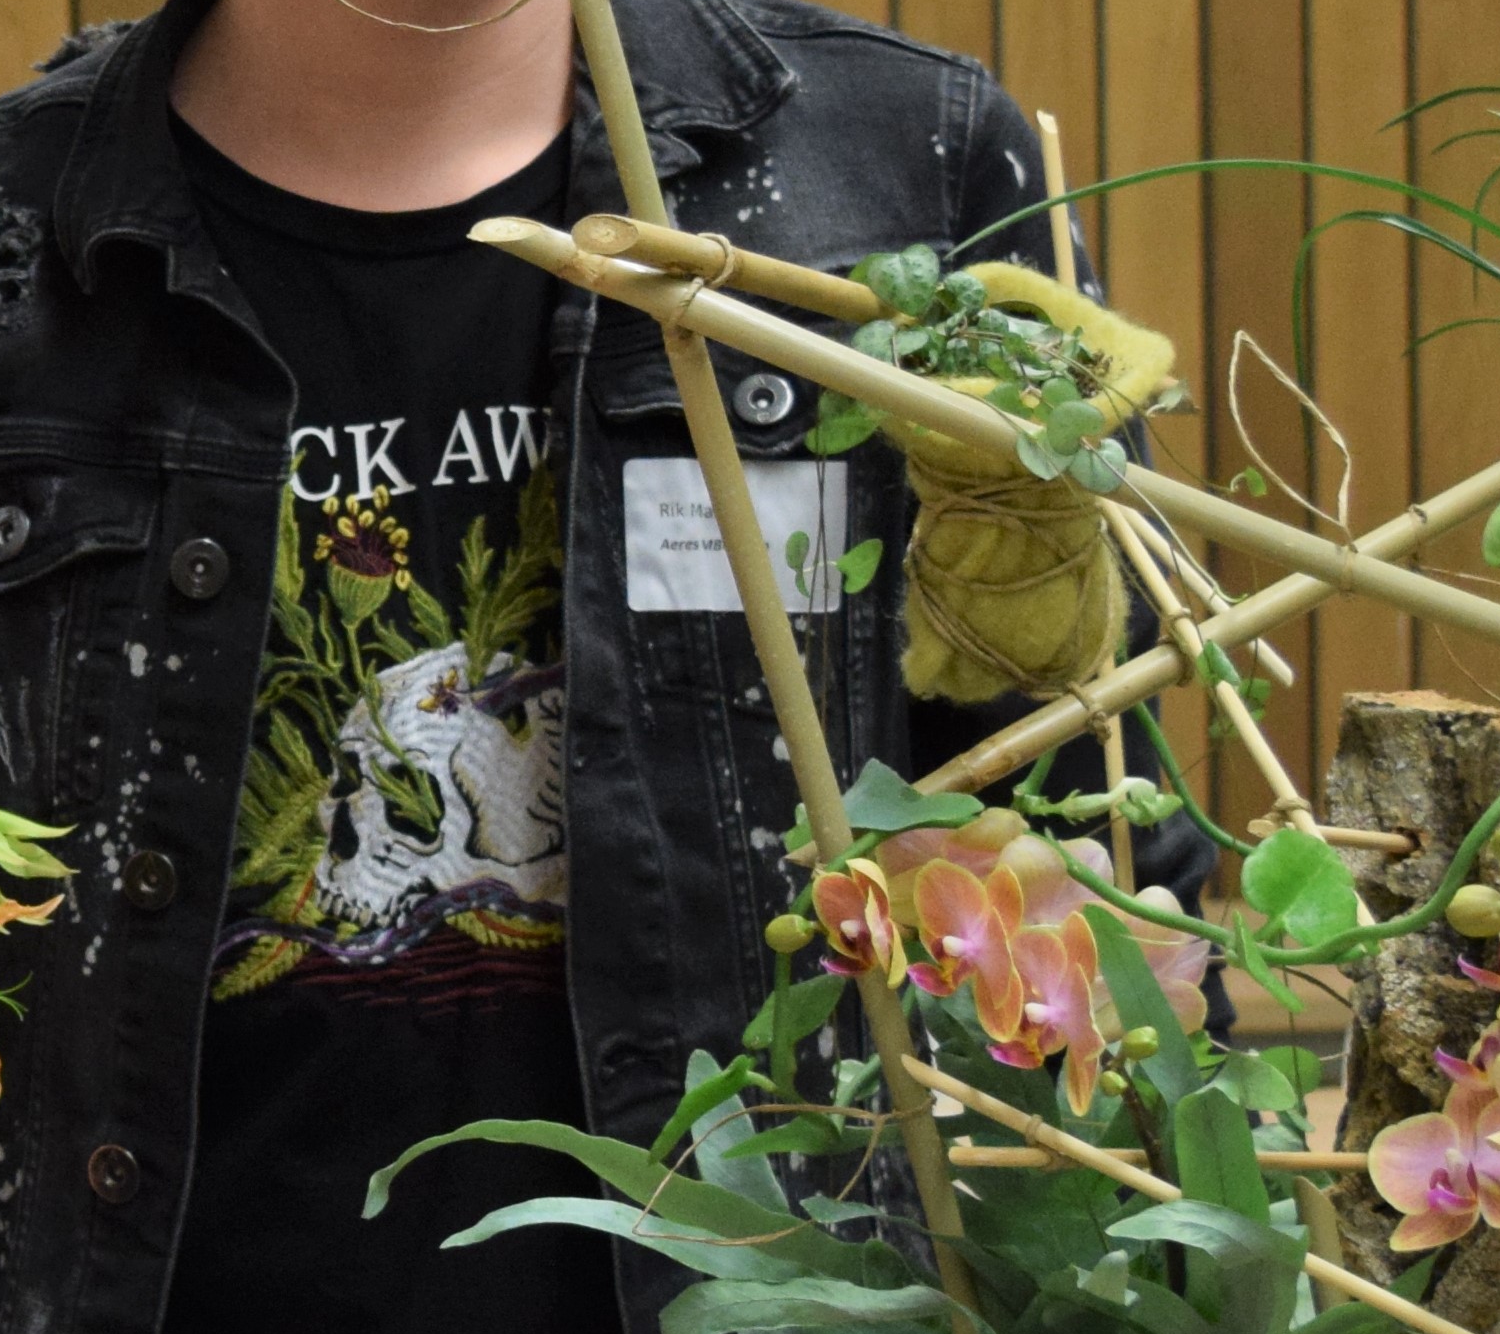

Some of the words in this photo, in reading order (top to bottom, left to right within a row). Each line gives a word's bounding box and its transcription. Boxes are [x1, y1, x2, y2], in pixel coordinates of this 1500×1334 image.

[289, 417, 417, 502] CK
[431, 405, 555, 485] AW
[660, 502, 684, 517] Rik
[691, 503, 714, 518] Ma
[660, 539, 699, 550] Aeres
[702, 539, 723, 551] MB
